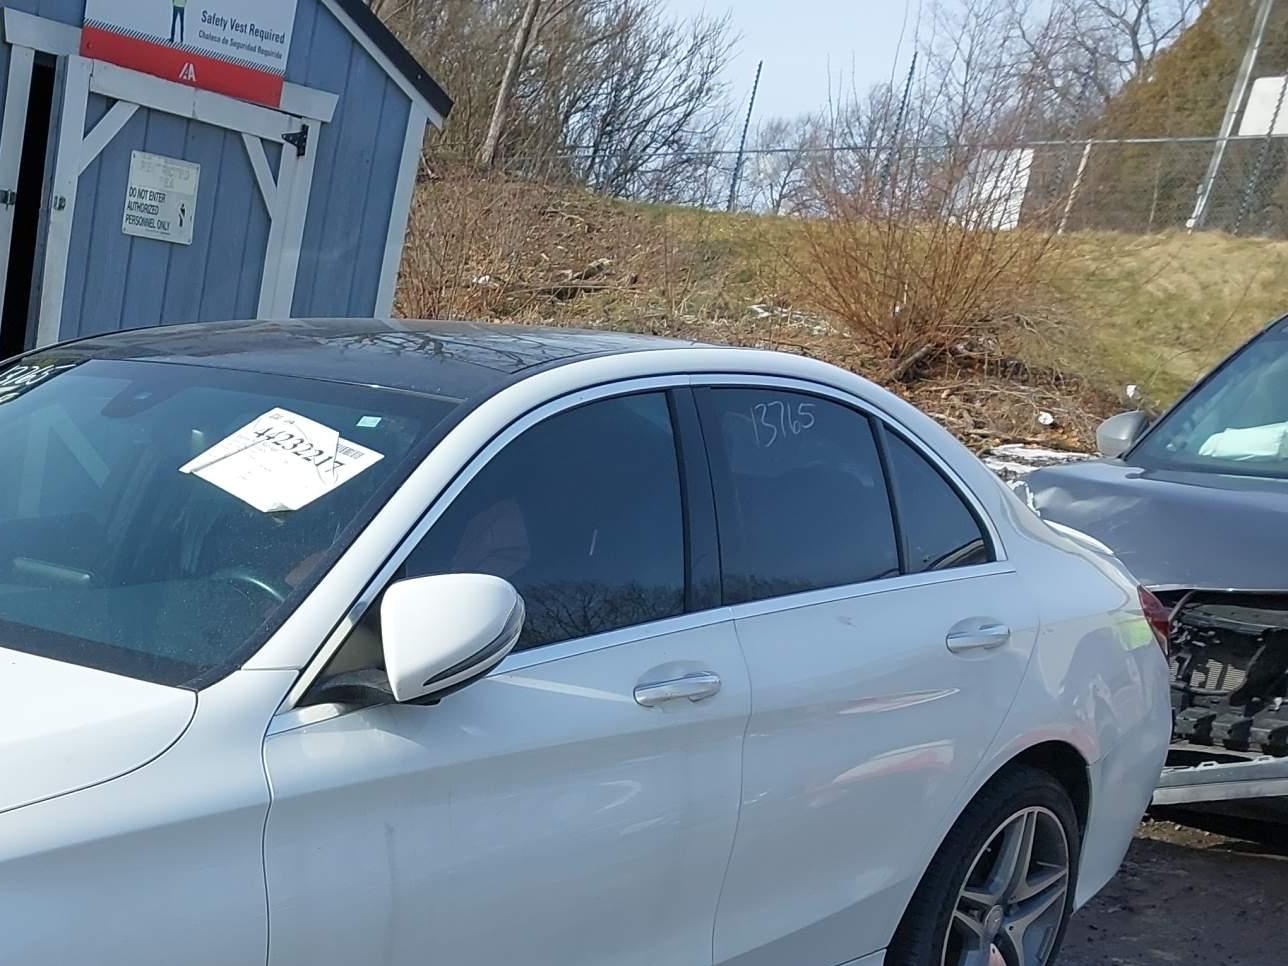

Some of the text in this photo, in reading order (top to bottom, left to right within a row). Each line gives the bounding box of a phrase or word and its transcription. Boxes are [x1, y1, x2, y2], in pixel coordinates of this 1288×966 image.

[201, 10, 285, 44] Safety Vest Required
[221, 36, 229, 45] de
[129, 186, 166, 203] DO NOT ENTER
[127, 200, 159, 216] AUTHORIZED
[125, 213, 170, 231] PERSONNEL ONLY
[750, 400, 816, 448] 13765
